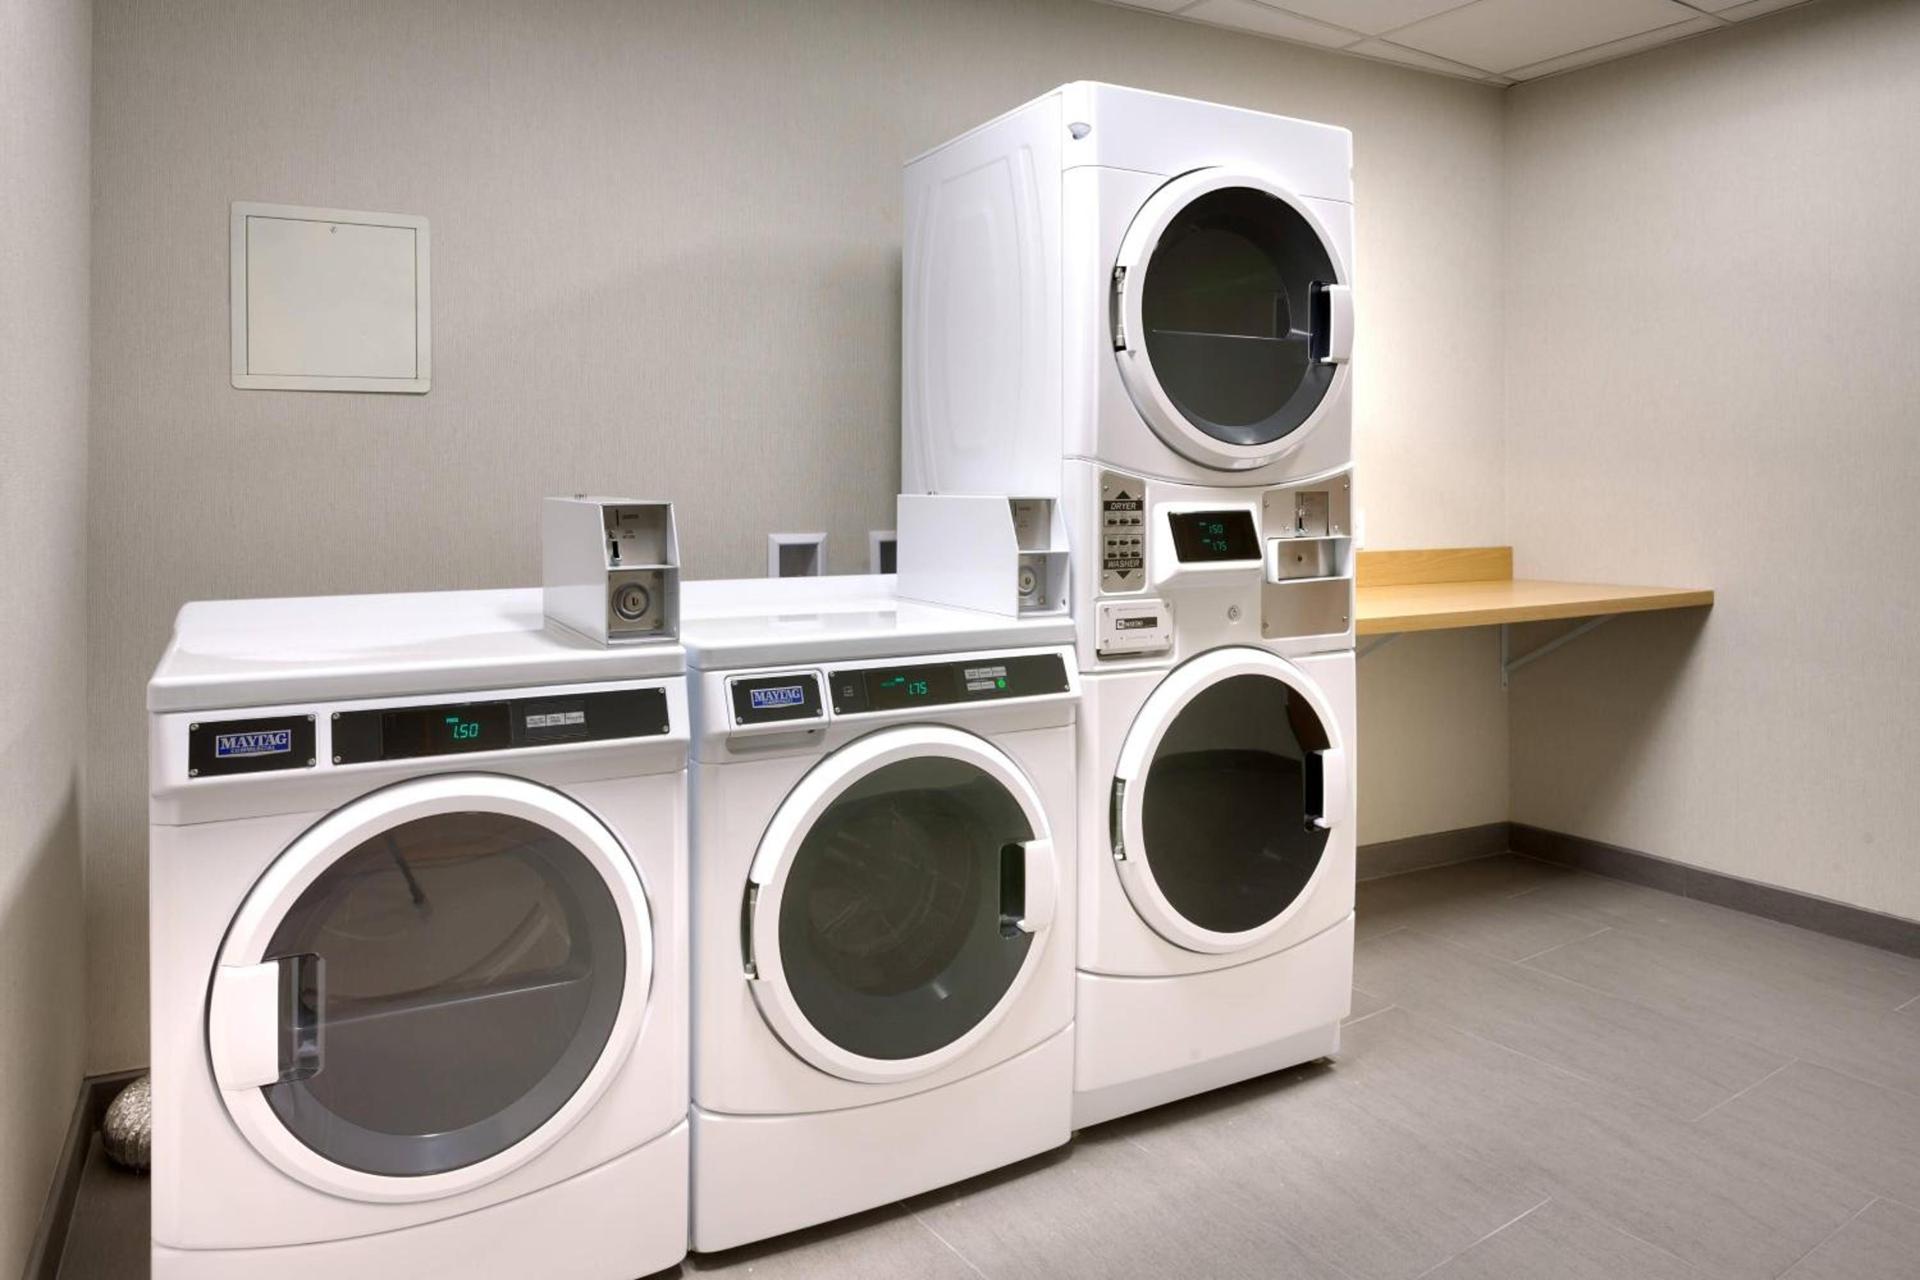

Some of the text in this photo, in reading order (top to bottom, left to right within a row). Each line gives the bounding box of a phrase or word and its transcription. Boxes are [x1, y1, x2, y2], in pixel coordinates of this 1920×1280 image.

[1110, 502, 1137, 510] DRYER
[1107, 559, 1140, 569] WASHER
[753, 688, 800, 702] MAYTAG
[219, 733, 288, 750] MAYTAG
